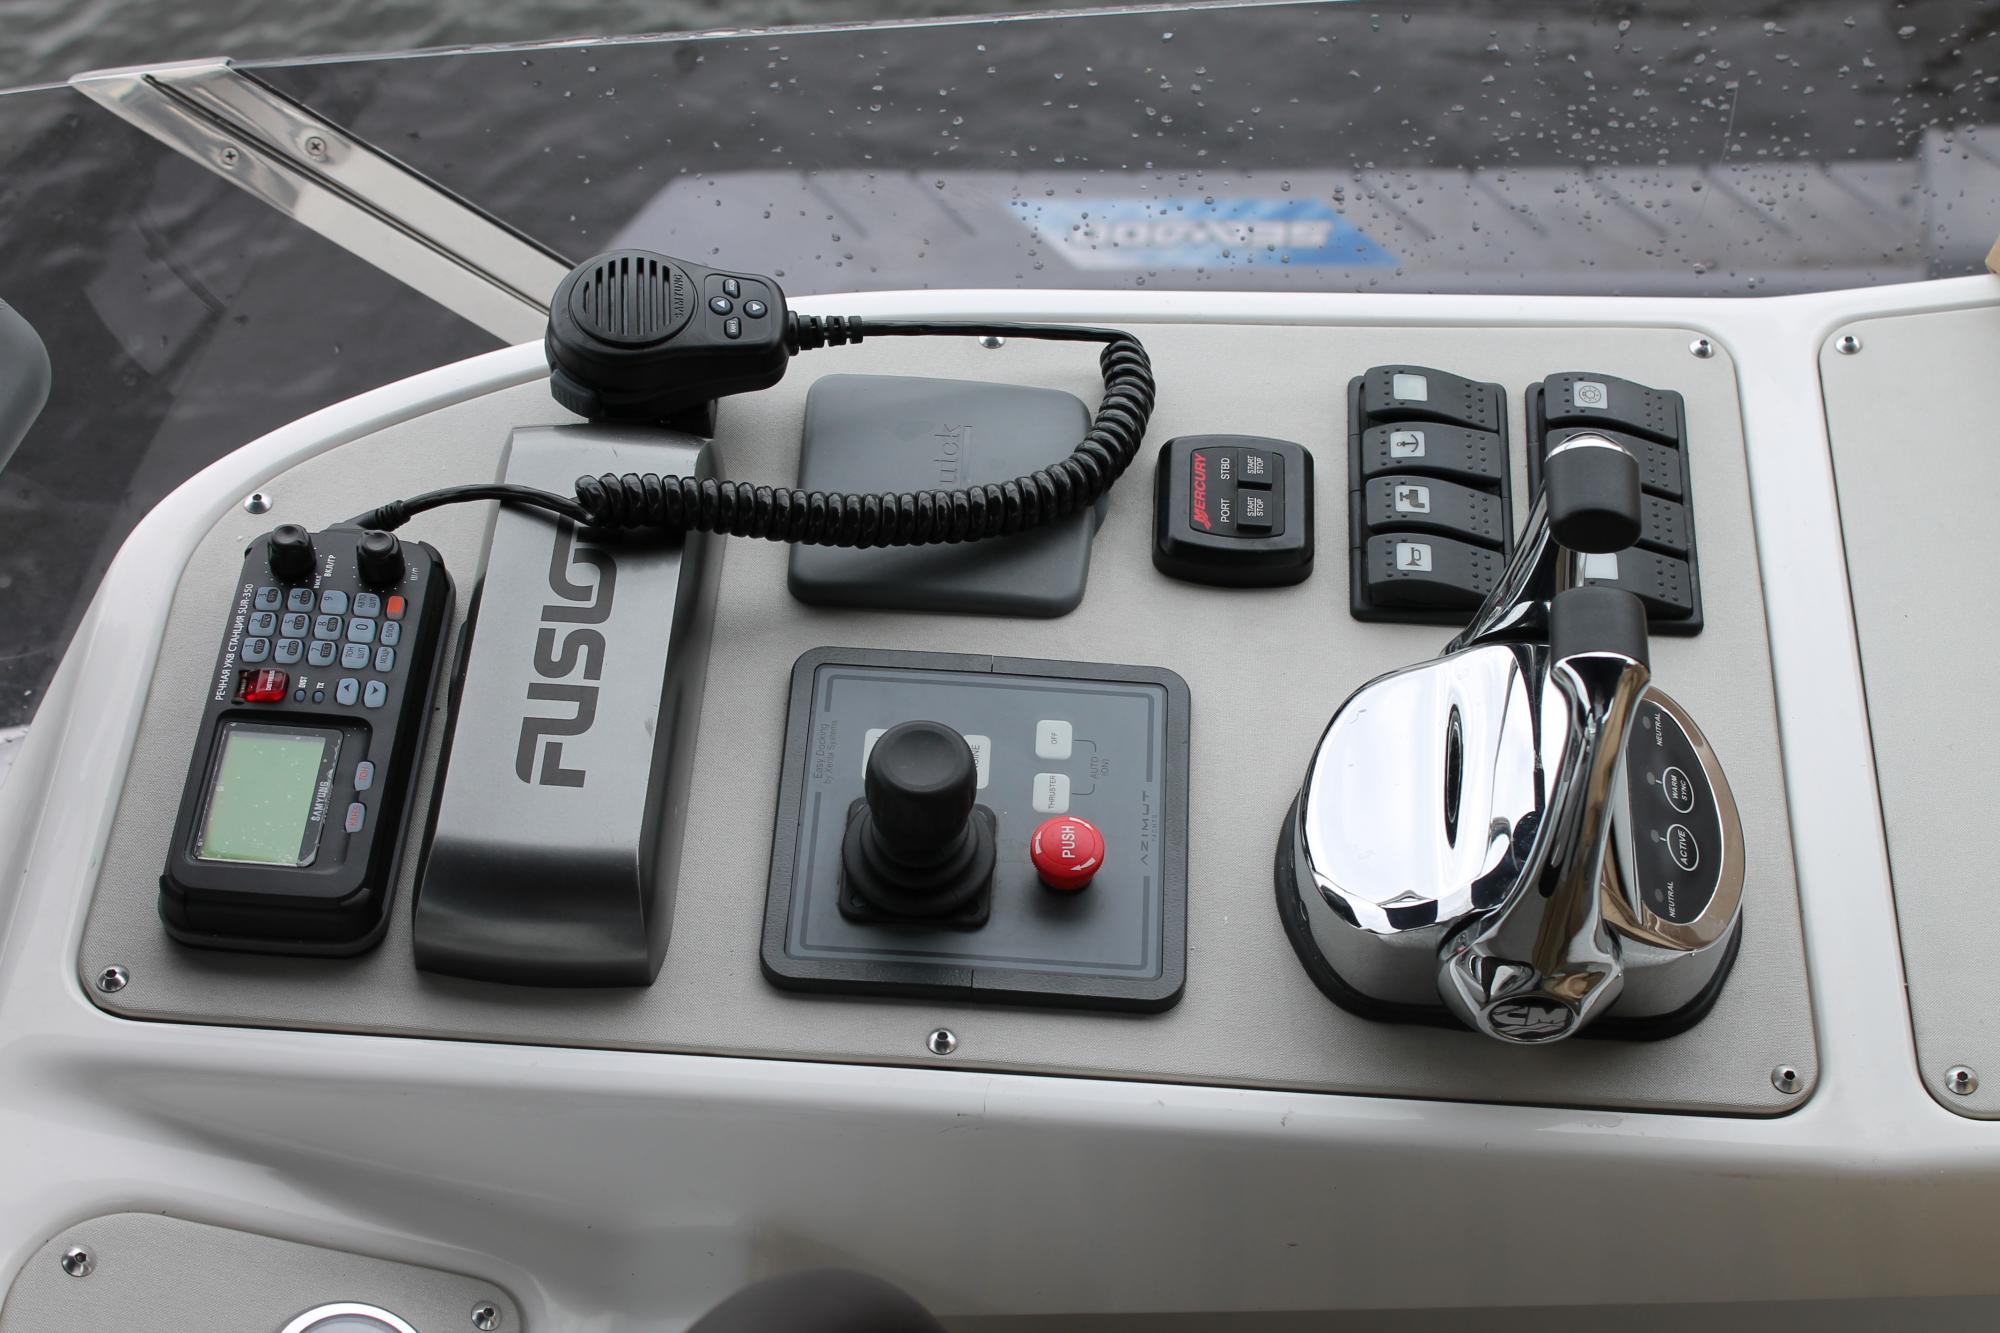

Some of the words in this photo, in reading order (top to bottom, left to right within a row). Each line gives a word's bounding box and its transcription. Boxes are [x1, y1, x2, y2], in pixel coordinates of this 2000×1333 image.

[1221, 457, 1230, 480] STBD
[1194, 453, 1212, 529] MERCURY
[1221, 498, 1230, 523] PORT
[324, 554, 336, 577] ВКЛ/ГР
[238, 583, 254, 614] SUR-350
[227, 615, 245, 653] СТАНЦИЯ
[222, 652, 235, 668] УКВ
[215, 669, 232, 701] РЕЧНАЯ
[298, 676, 308, 688] DIST
[1050, 732, 1058, 745] OFF
[310, 781, 329, 822] SAMYUNG
[1048, 775, 1056, 809] THRUSTER
[1061, 825, 1076, 858] PUSH
[1140, 791, 1150, 866] AZIMUT
[1678, 829, 1688, 866] ACTIVE
